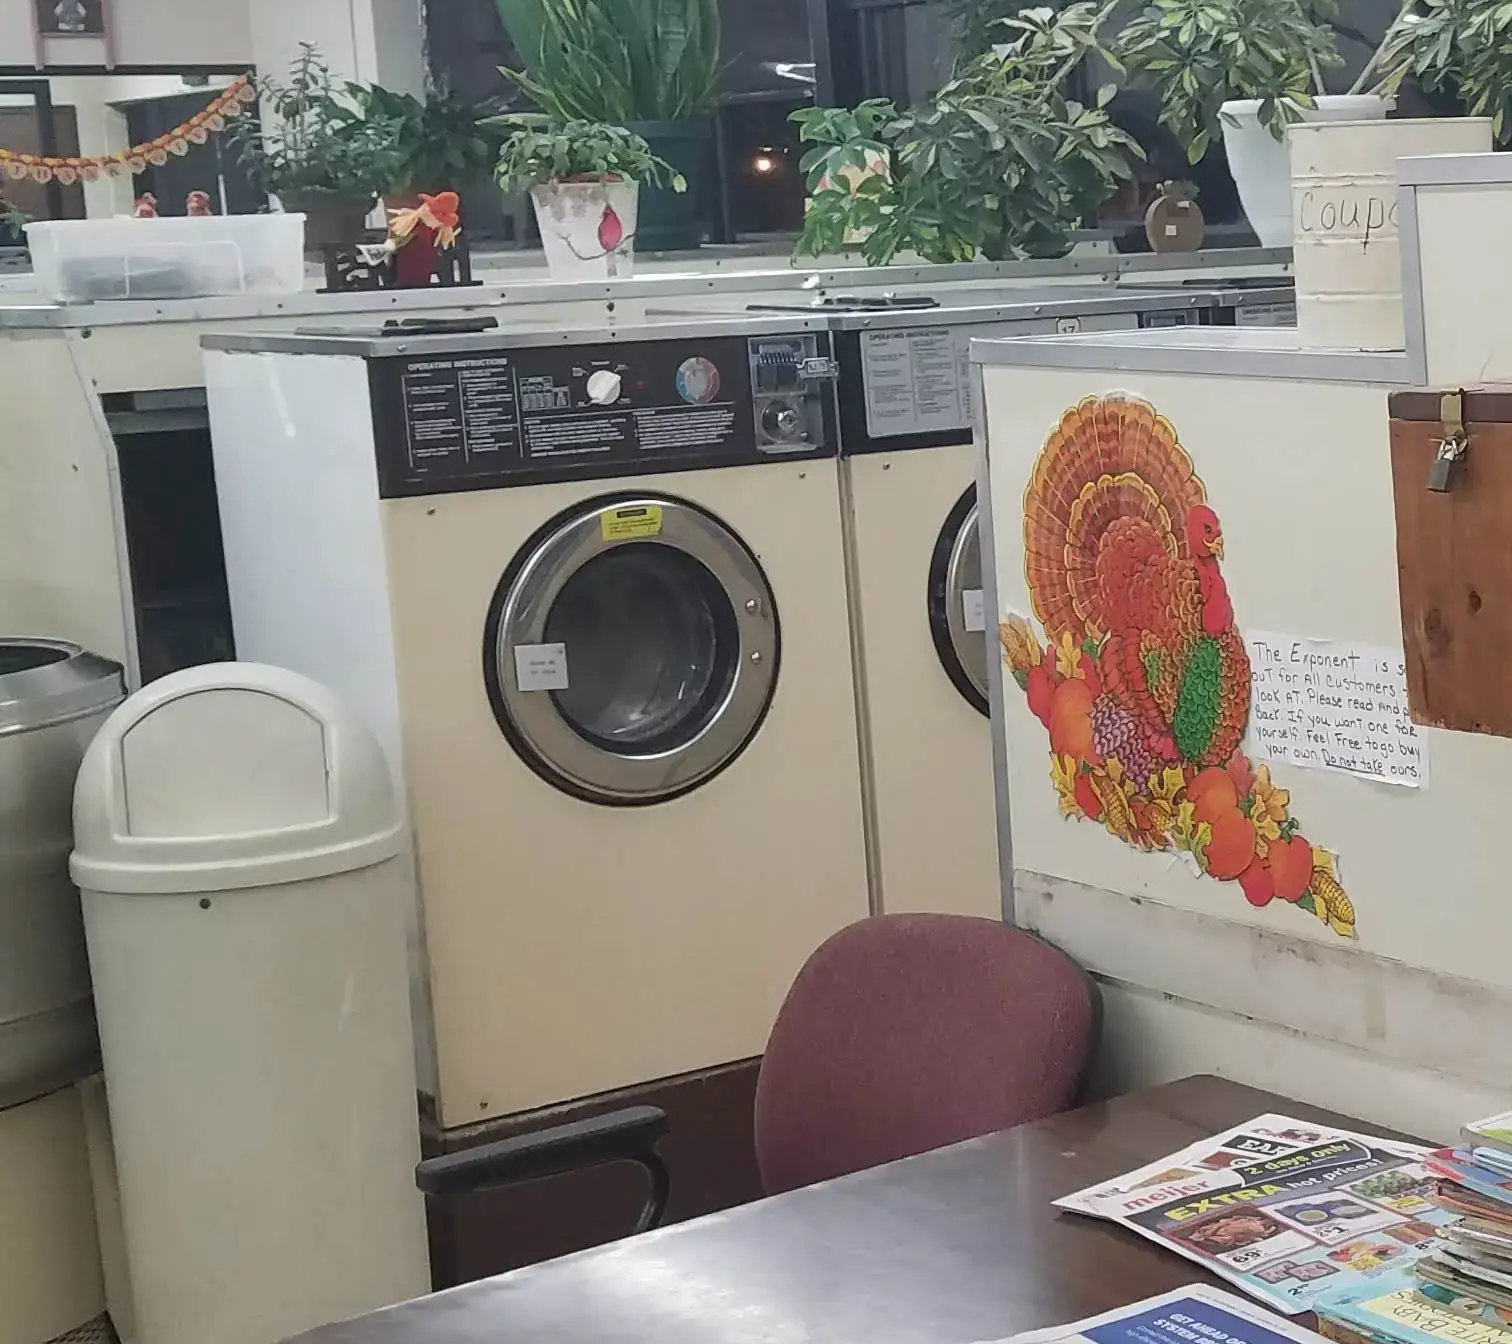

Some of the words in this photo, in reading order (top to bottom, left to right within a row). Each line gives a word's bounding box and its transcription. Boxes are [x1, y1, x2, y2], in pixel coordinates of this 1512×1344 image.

[1253, 642, 1282, 662] The
[1291, 642, 1361, 672] Exponent
[1375, 659, 1389, 673] is
[1278, 668, 1298, 683] for
[1308, 688, 1343, 708] Please
[1347, 698, 1373, 712] read
[1287, 709, 1304, 724] If
[1307, 714, 1332, 728] you
[1368, 721, 1389, 735] one
[1265, 743, 1288, 759] your
[1322, 748, 1337, 765] Do
[1339, 755, 1358, 769] not
[1361, 757, 1384, 774] take
[1306, 729, 1331, 744] Feel
[1335, 732, 1362, 750] Free
[1400, 741, 1421, 764] buy
[1243, 1167, 1264, 1175] 2
[1264, 1155, 1310, 1170] days
[1311, 1143, 1351, 1158] Only
[1123, 1180, 1210, 1211] meijer
[1163, 1184, 1286, 1222] EXTRA
[1286, 1177, 1322, 1189] hot
[1153, 1319, 1199, 1343] SYSTEM
[1169, 1313, 1194, 1324] GET
[1189, 1317, 1229, 1340] AHEAD
[1391, 1306, 1450, 1333] BABY
